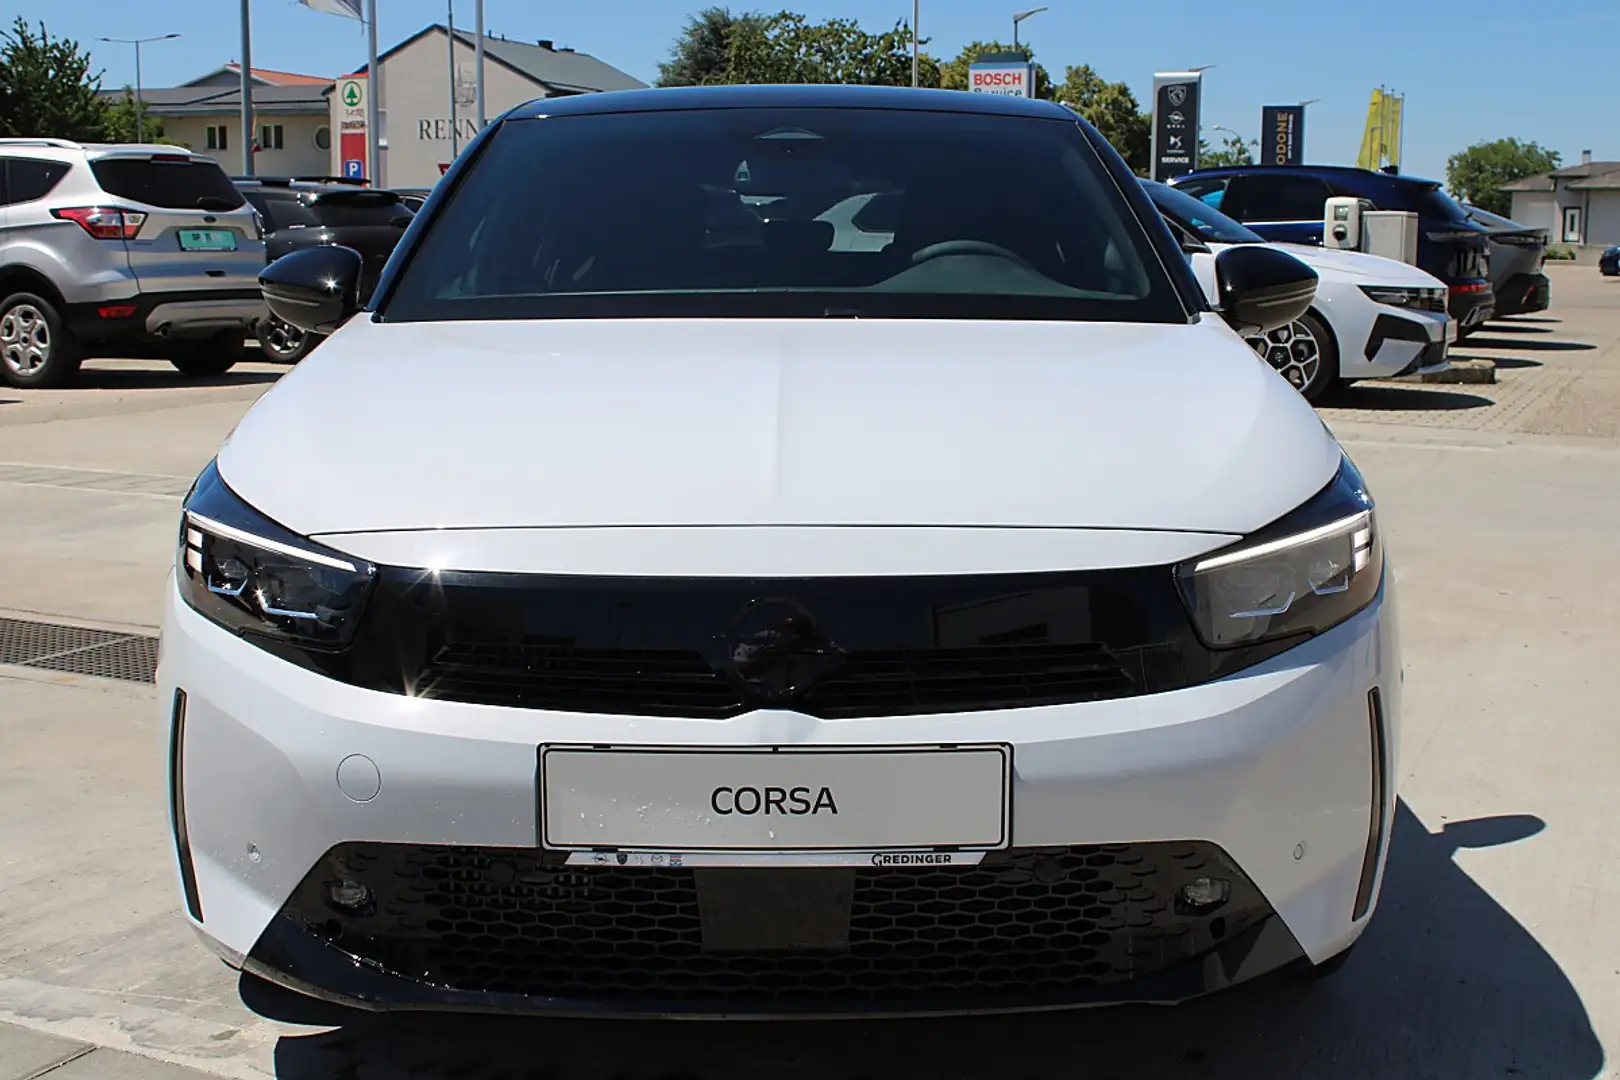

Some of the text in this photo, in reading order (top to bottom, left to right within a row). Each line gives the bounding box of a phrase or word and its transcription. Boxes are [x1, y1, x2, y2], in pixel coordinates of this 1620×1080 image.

[974, 73, 1022, 85] BOSCH
[349, 163, 359, 176] P
[711, 787, 838, 815] CORSA
